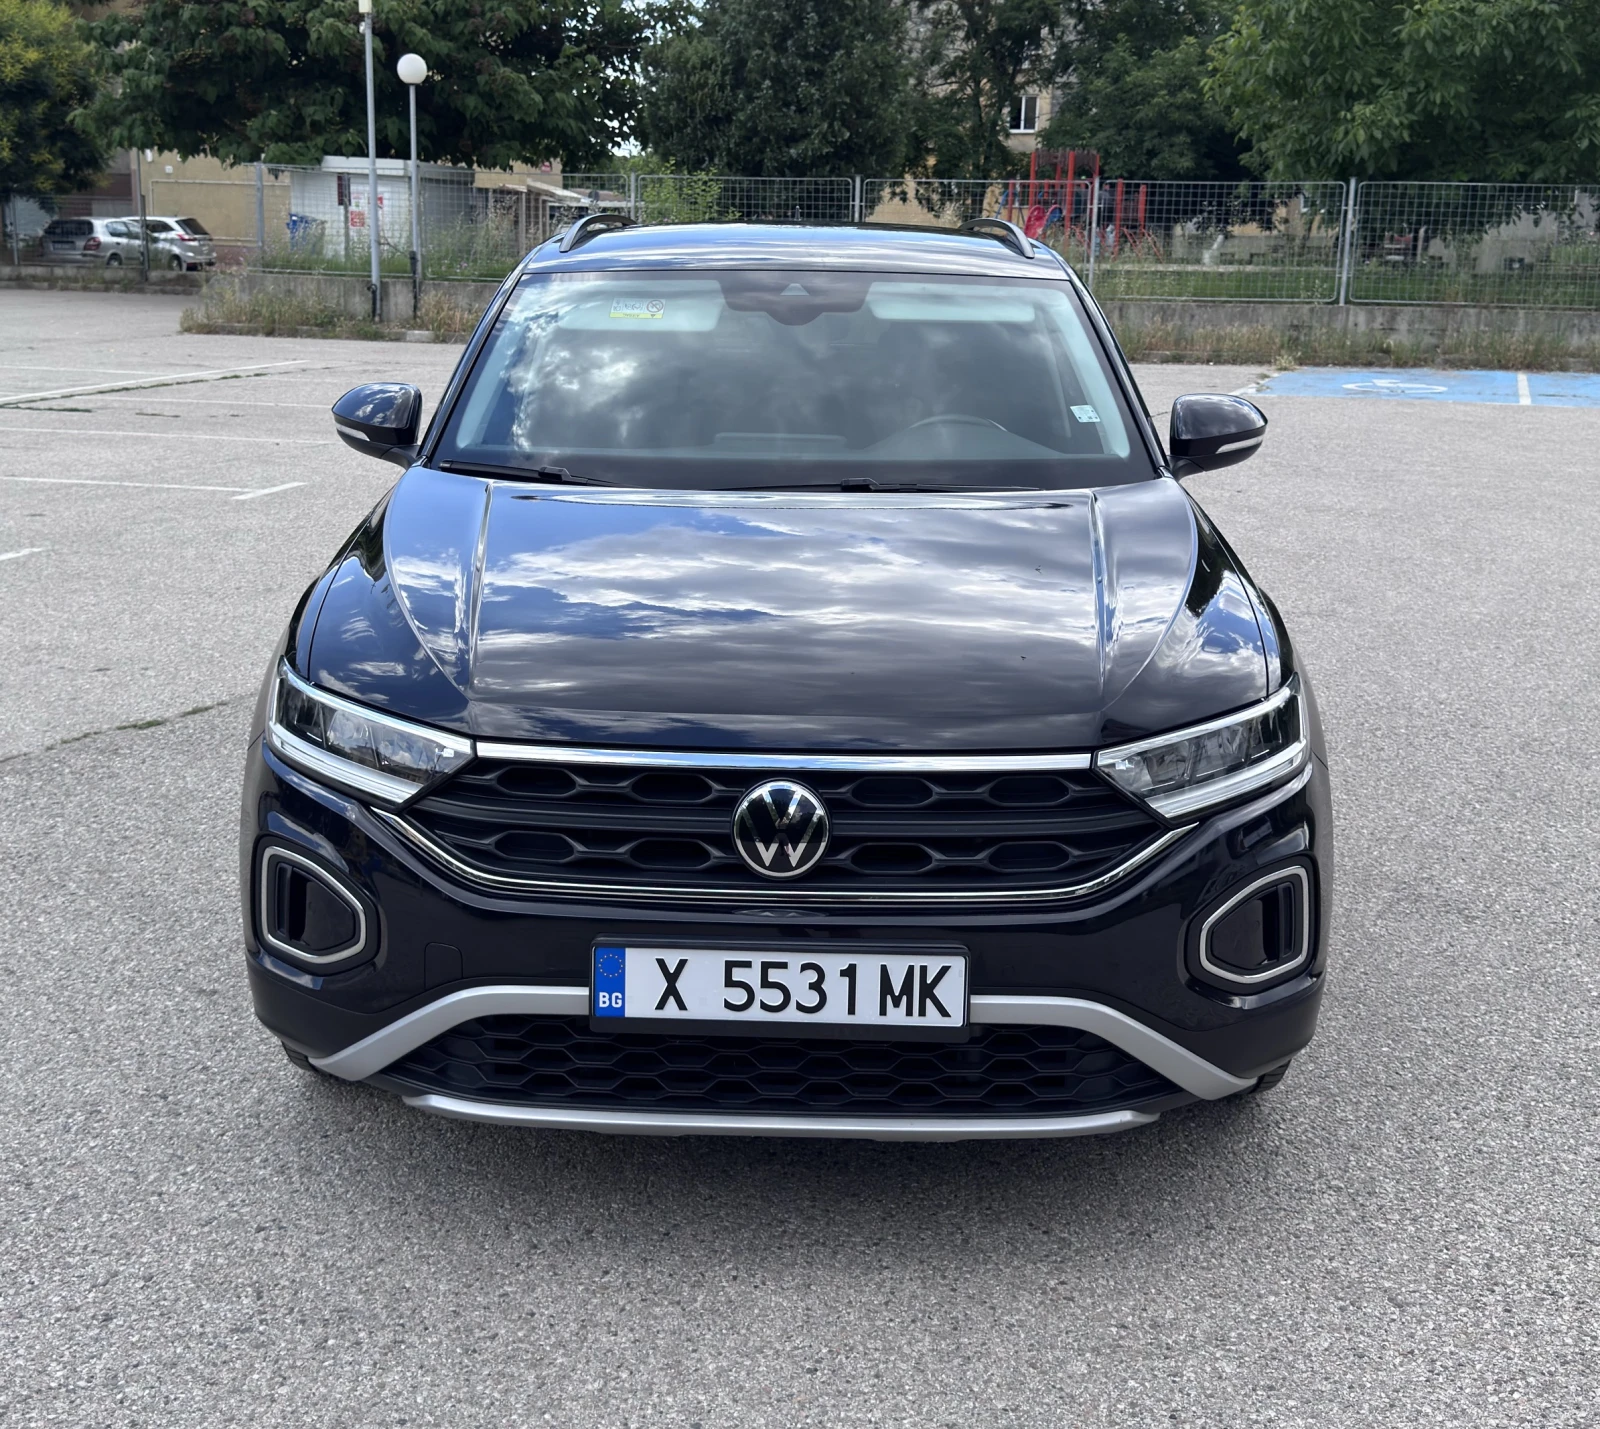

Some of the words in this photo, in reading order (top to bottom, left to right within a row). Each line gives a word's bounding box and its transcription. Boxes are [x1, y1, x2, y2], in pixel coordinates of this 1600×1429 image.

[599, 992, 622, 1008] BG
[654, 958, 689, 1011] X
[723, 960, 857, 1015] 5531
[879, 964, 952, 1018] MK
